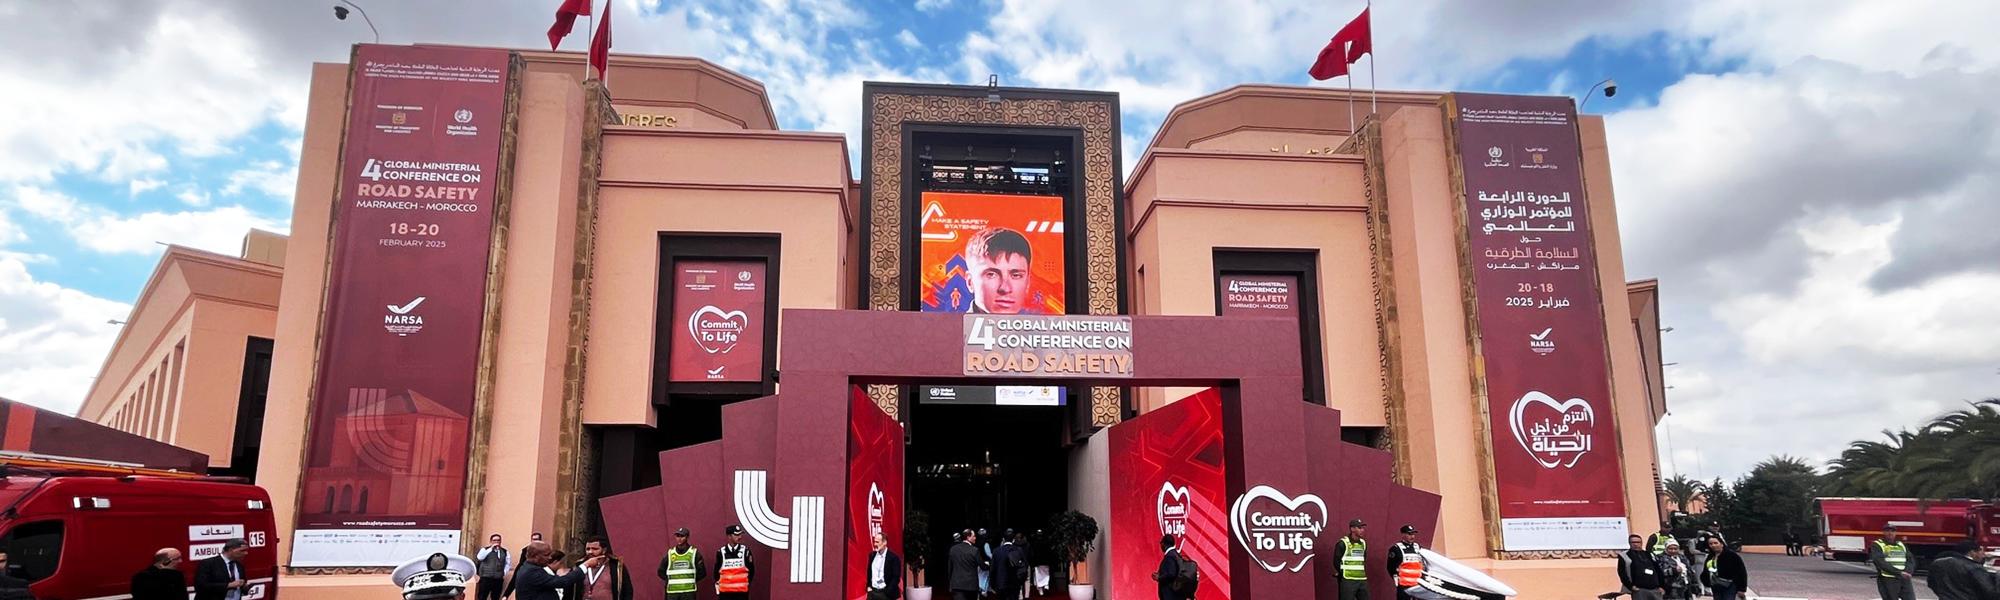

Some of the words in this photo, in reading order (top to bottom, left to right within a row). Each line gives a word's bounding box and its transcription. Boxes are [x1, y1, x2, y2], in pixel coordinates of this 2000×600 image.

[384, 160, 420, 169] GLOBAL
[422, 162, 480, 172] MINISTERIAL
[382, 171, 459, 182] CONFERENCE
[462, 174, 480, 183] ON
[358, 184, 411, 198] ROAD
[414, 186, 478, 200] SAFETY
[1479, 191, 1524, 204] الرابعة
[1528, 192, 1570, 204] الدورة
[356, 200, 418, 210] MARRAKECH
[426, 203, 477, 212] MOROCCO
[1481, 205, 1526, 220] الوزاري
[1529, 206, 1572, 219] للمؤتمر
[390, 223, 439, 235] 18-20
[1482, 221, 1575, 234] العالمي
[380, 239, 423, 247] FEBRUARY
[1485, 247, 1531, 260] الطرقية
[1536, 248, 1578, 259] السلامة
[1537, 262, 1579, 270] مراكش
[1518, 283, 1532, 292] 20
[1540, 283, 1554, 292] 18
[1506, 297, 1533, 306] 2025
[1538, 296, 1570, 308] فبراير
[385, 315, 423, 324] NARSA
[701, 320, 737, 328] Commit
[997, 320, 1047, 331] GLOBAL
[1050, 320, 1129, 332] MINISTERIAL
[701, 332, 713, 341] To
[717, 332, 737, 344] Life
[998, 334, 1102, 349] CONFERENCE
[1104, 336, 1130, 350] ON
[967, 352, 1040, 372] ROAD
[1044, 352, 1130, 373] SAFETY
[1530, 418, 1550, 436] أجل
[1553, 424, 1569, 435] من
[1532, 435, 1591, 456] الحياة
[1164, 502, 1184, 515] Commit
[1251, 512, 1311, 526] Commit
[201, 526, 234, 536] إسعاف
[1165, 520, 1172, 534] To
[1173, 520, 1185, 538] Life
[1253, 533, 1275, 550] To
[1280, 533, 1313, 554] Life
[195, 547, 224, 556] AMBUL
